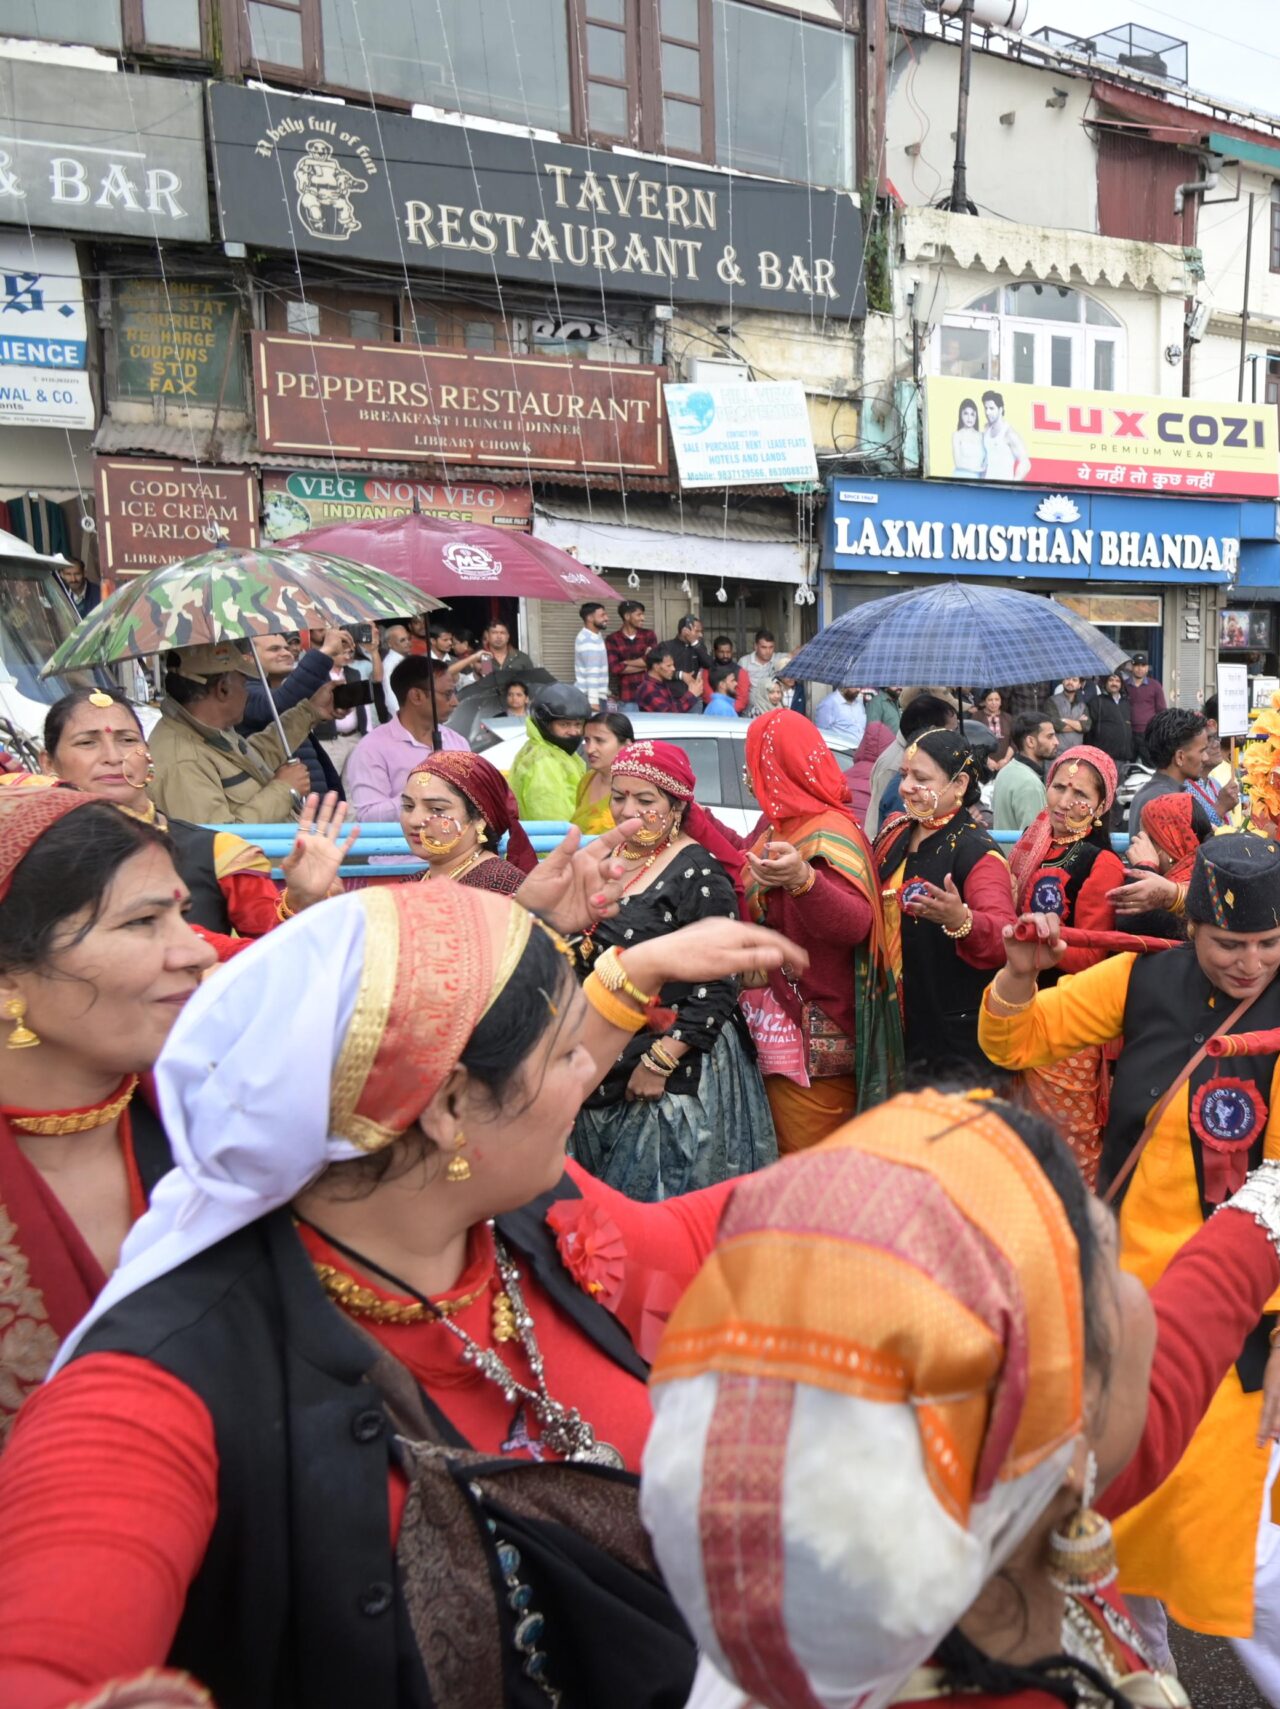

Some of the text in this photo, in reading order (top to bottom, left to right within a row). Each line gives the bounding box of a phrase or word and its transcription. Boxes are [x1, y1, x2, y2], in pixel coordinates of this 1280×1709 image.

[266, 117, 305, 141] belly
[308, 116, 337, 135] full
[339, 132, 360, 146] of
[356, 145, 377, 175] fun
[51, 157, 189, 220] BAR
[544, 163, 717, 231] TAVERN
[406, 199, 840, 299] RESTAURANT & BAR
[0, 341, 80, 364] IENCE
[153, 361, 198, 378] STD
[36, 388, 48, 403] &
[52, 390, 78, 405] CO.
[150, 378, 198, 396] FAX
[276, 371, 651, 424] PEPPERS RESTAURANT
[359, 409, 581, 436] BREAKFAST LUNCH DINNER
[1032, 403, 1265, 449] LUX COZI
[414, 435, 532, 453] LIBRARY CHOWK
[683, 438, 807, 453] SALE PURCHASE RENT LEASE FLATS
[1090, 442, 1214, 459] PREMIUM WEAR
[709, 452, 787, 464] HOTELS AND LANDS
[298, 476, 357, 499] VEG
[1078, 463, 1216, 489] ये नहीं तो कुछ नहीं
[130, 480, 228, 500] GODIYAL
[372, 481, 497, 508] NON VEG
[121, 501, 239, 521] ICE CREAM
[323, 503, 473, 523] INDIAN CNESE
[131, 522, 231, 541] PARLOUR
[834, 517, 1241, 574] LAXMI MISTHAN BHANDAR
